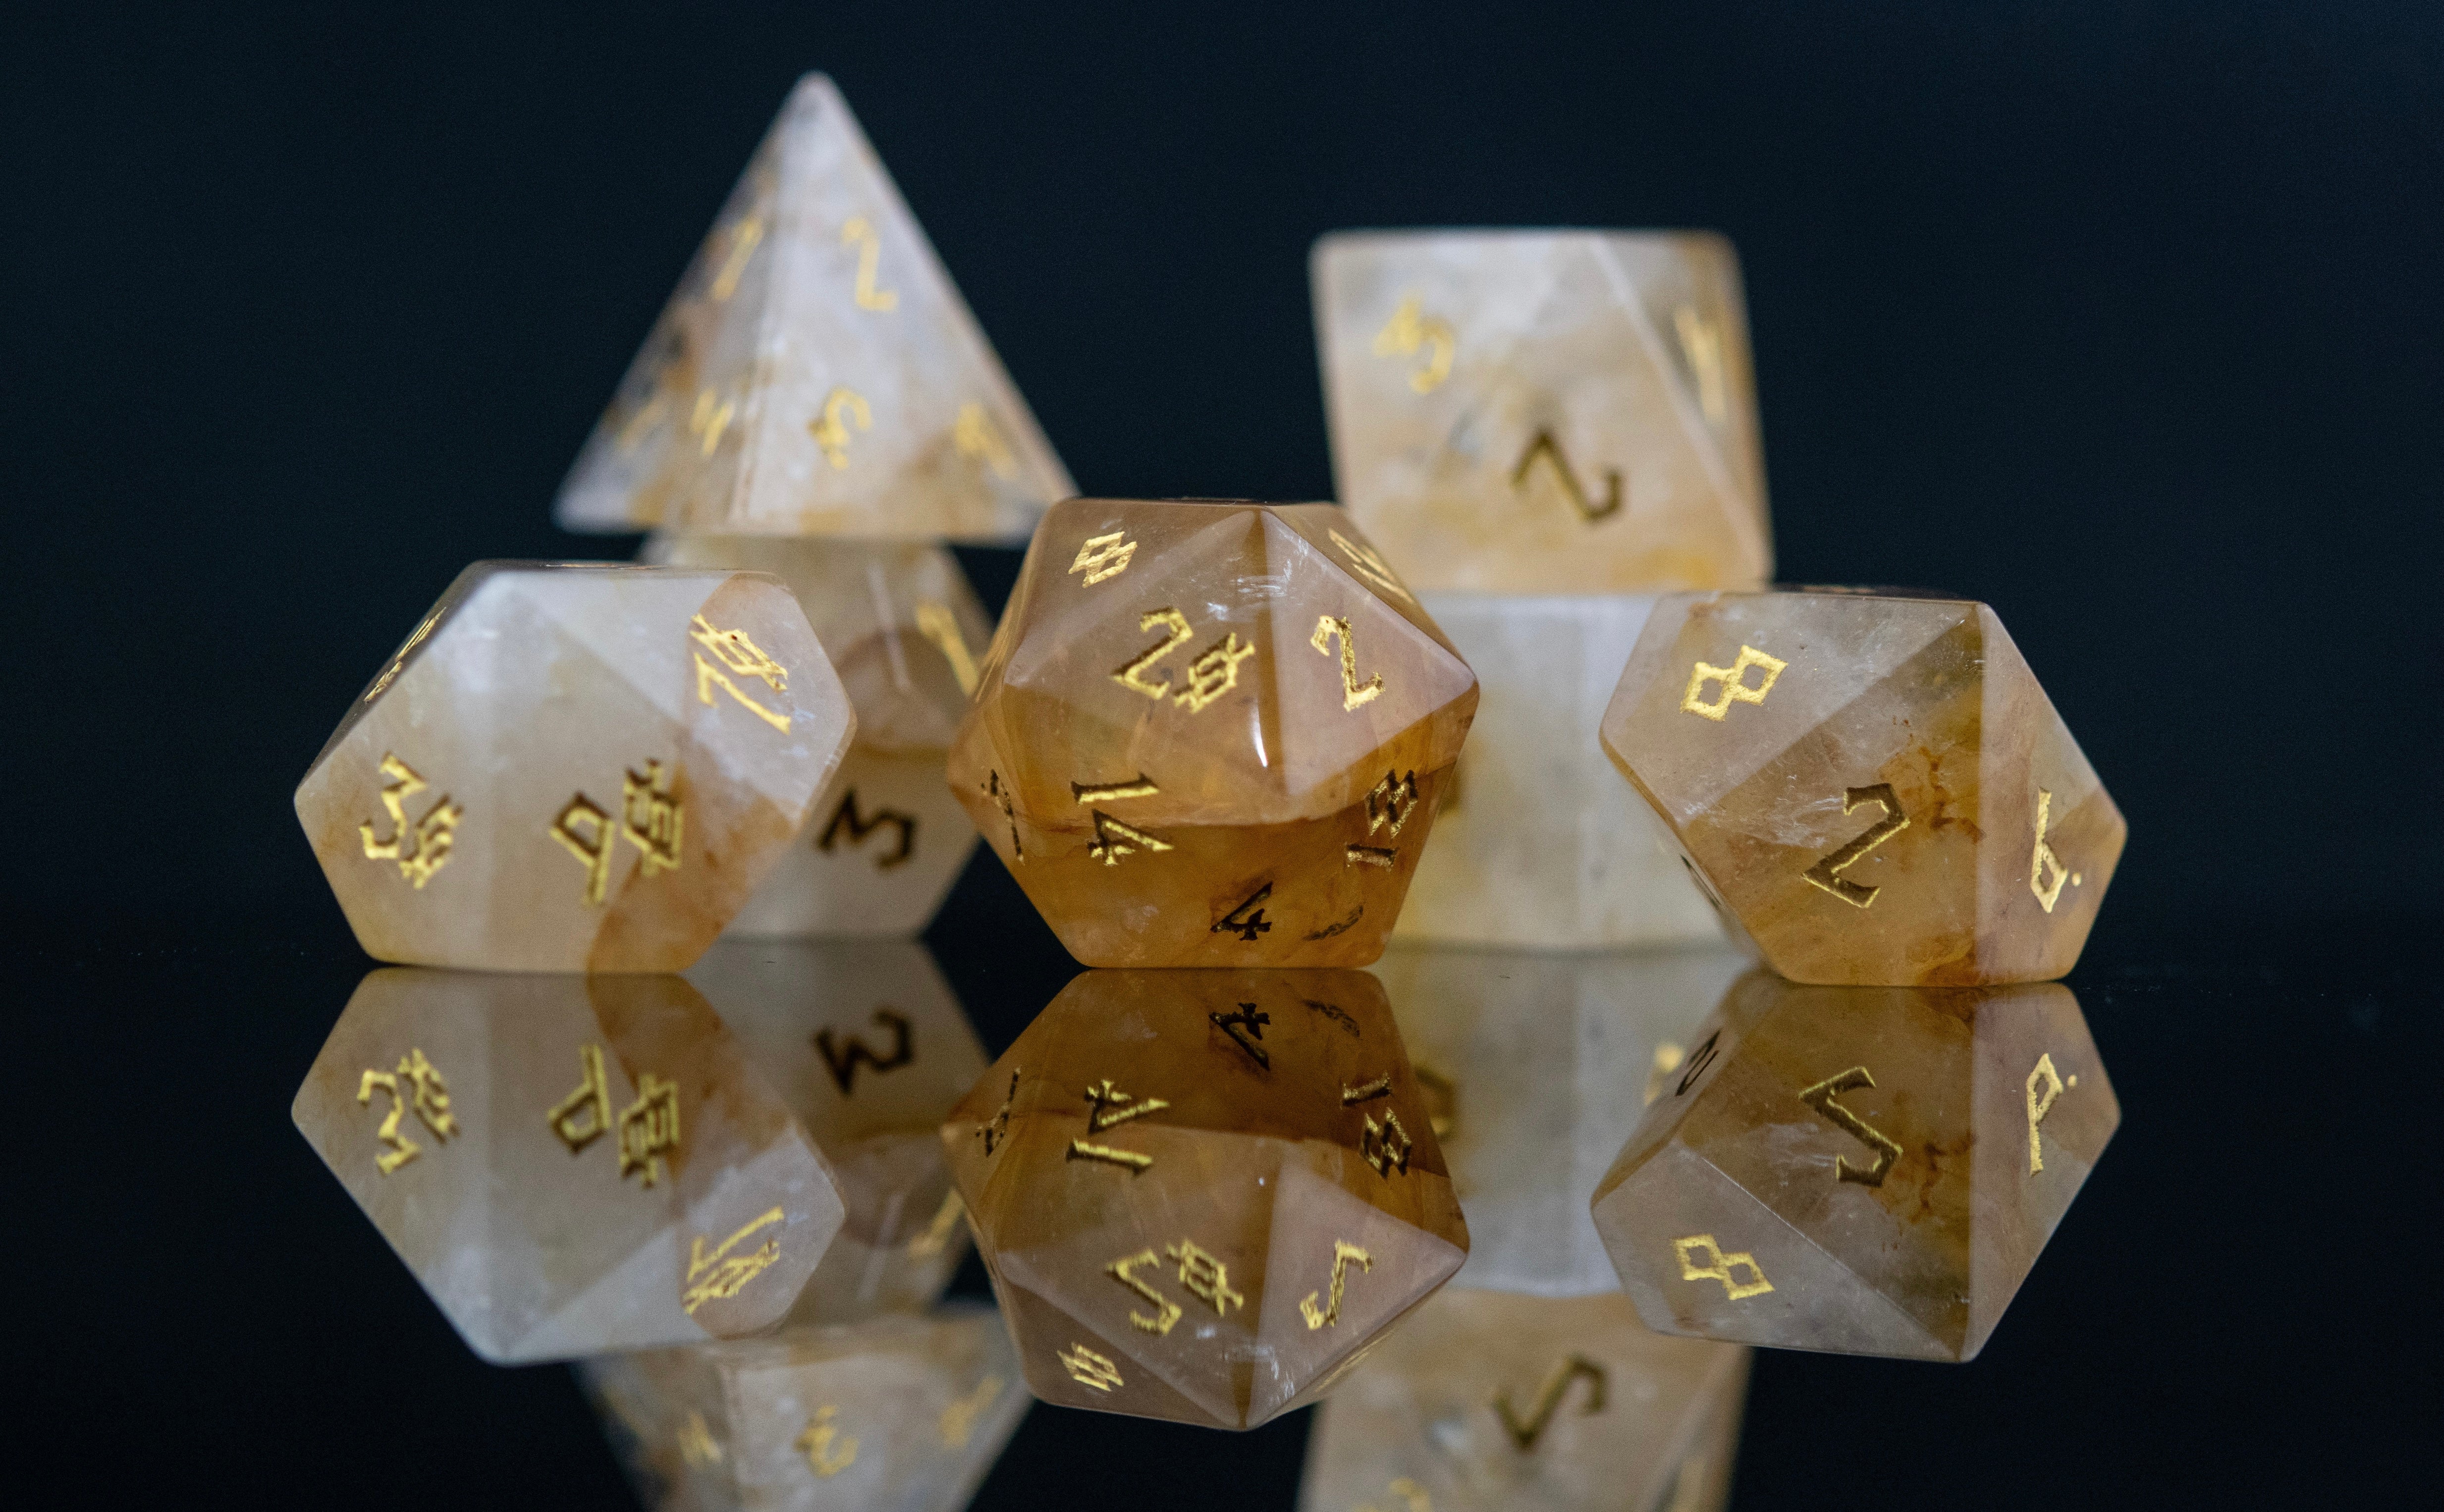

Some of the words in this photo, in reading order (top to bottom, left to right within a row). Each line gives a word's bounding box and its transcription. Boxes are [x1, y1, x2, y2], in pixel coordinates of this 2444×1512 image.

[841, 215, 898, 311] 2
[1068, 530, 1138, 588] 8
[1110, 605, 1256, 713] 20
[1309, 614, 1385, 712] 2
[1681, 644, 1790, 722] 8
[1070, 770, 1174, 867] 14
[1800, 782, 1911, 909] 2
[1210, 880, 1274, 942] 4
